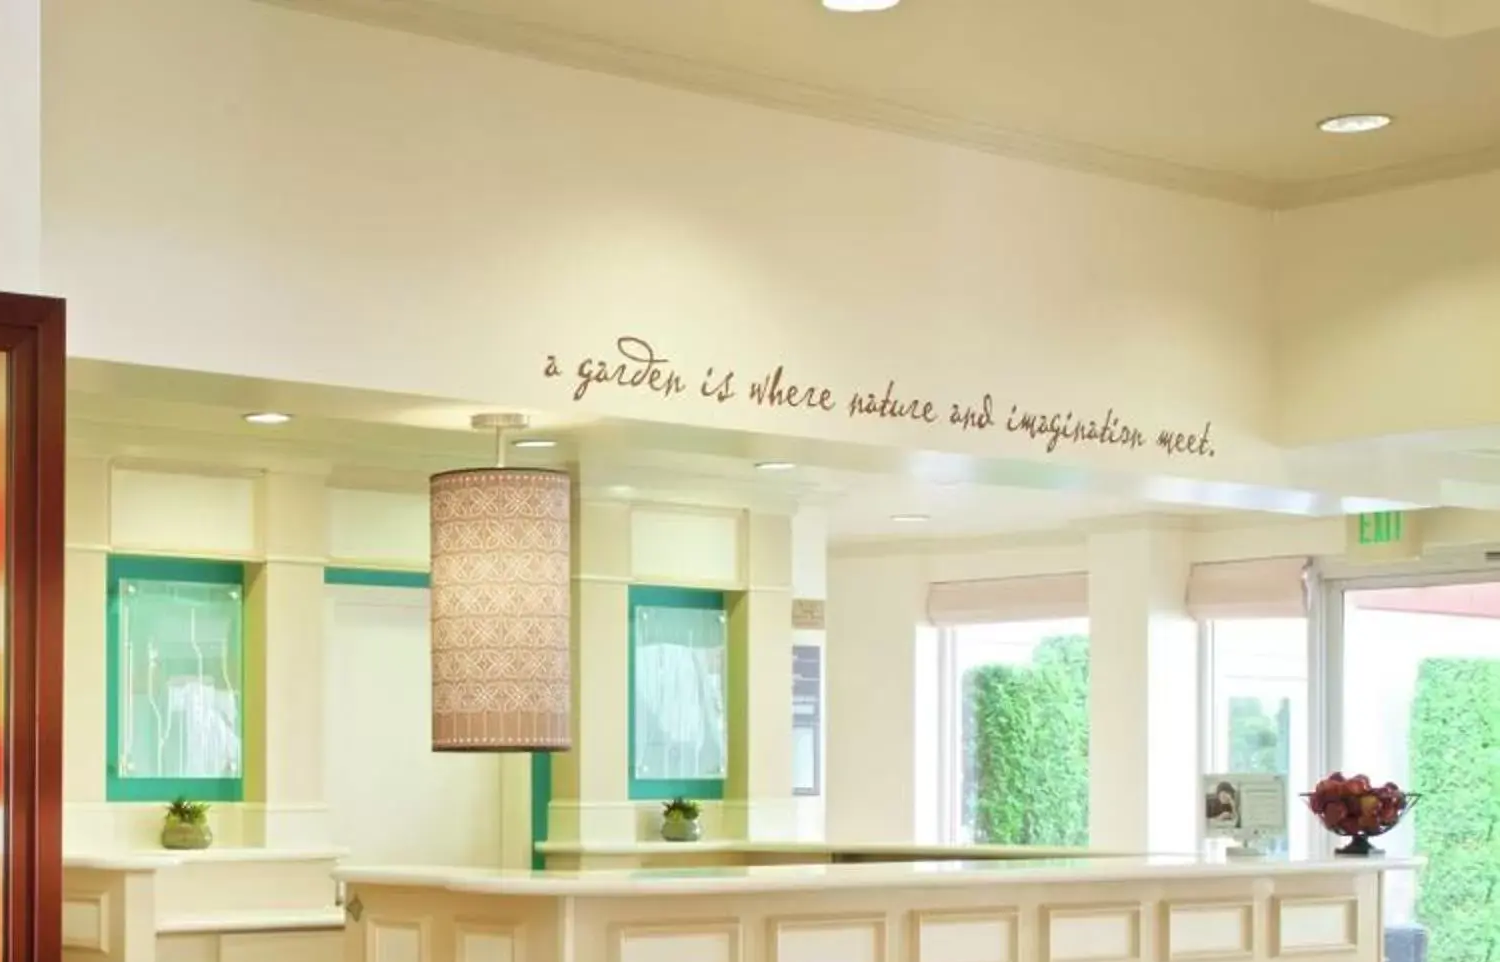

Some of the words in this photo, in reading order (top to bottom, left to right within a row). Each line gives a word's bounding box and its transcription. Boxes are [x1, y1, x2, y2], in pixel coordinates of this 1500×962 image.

[544, 355, 562, 377] a
[573, 336, 686, 401] garden
[701, 367, 735, 402] is
[749, 365, 836, 411] where
[849, 380, 938, 423] nature
[950, 393, 995, 431] and
[1007, 404, 1146, 453] imagination
[1156, 421, 1214, 457] meet.
